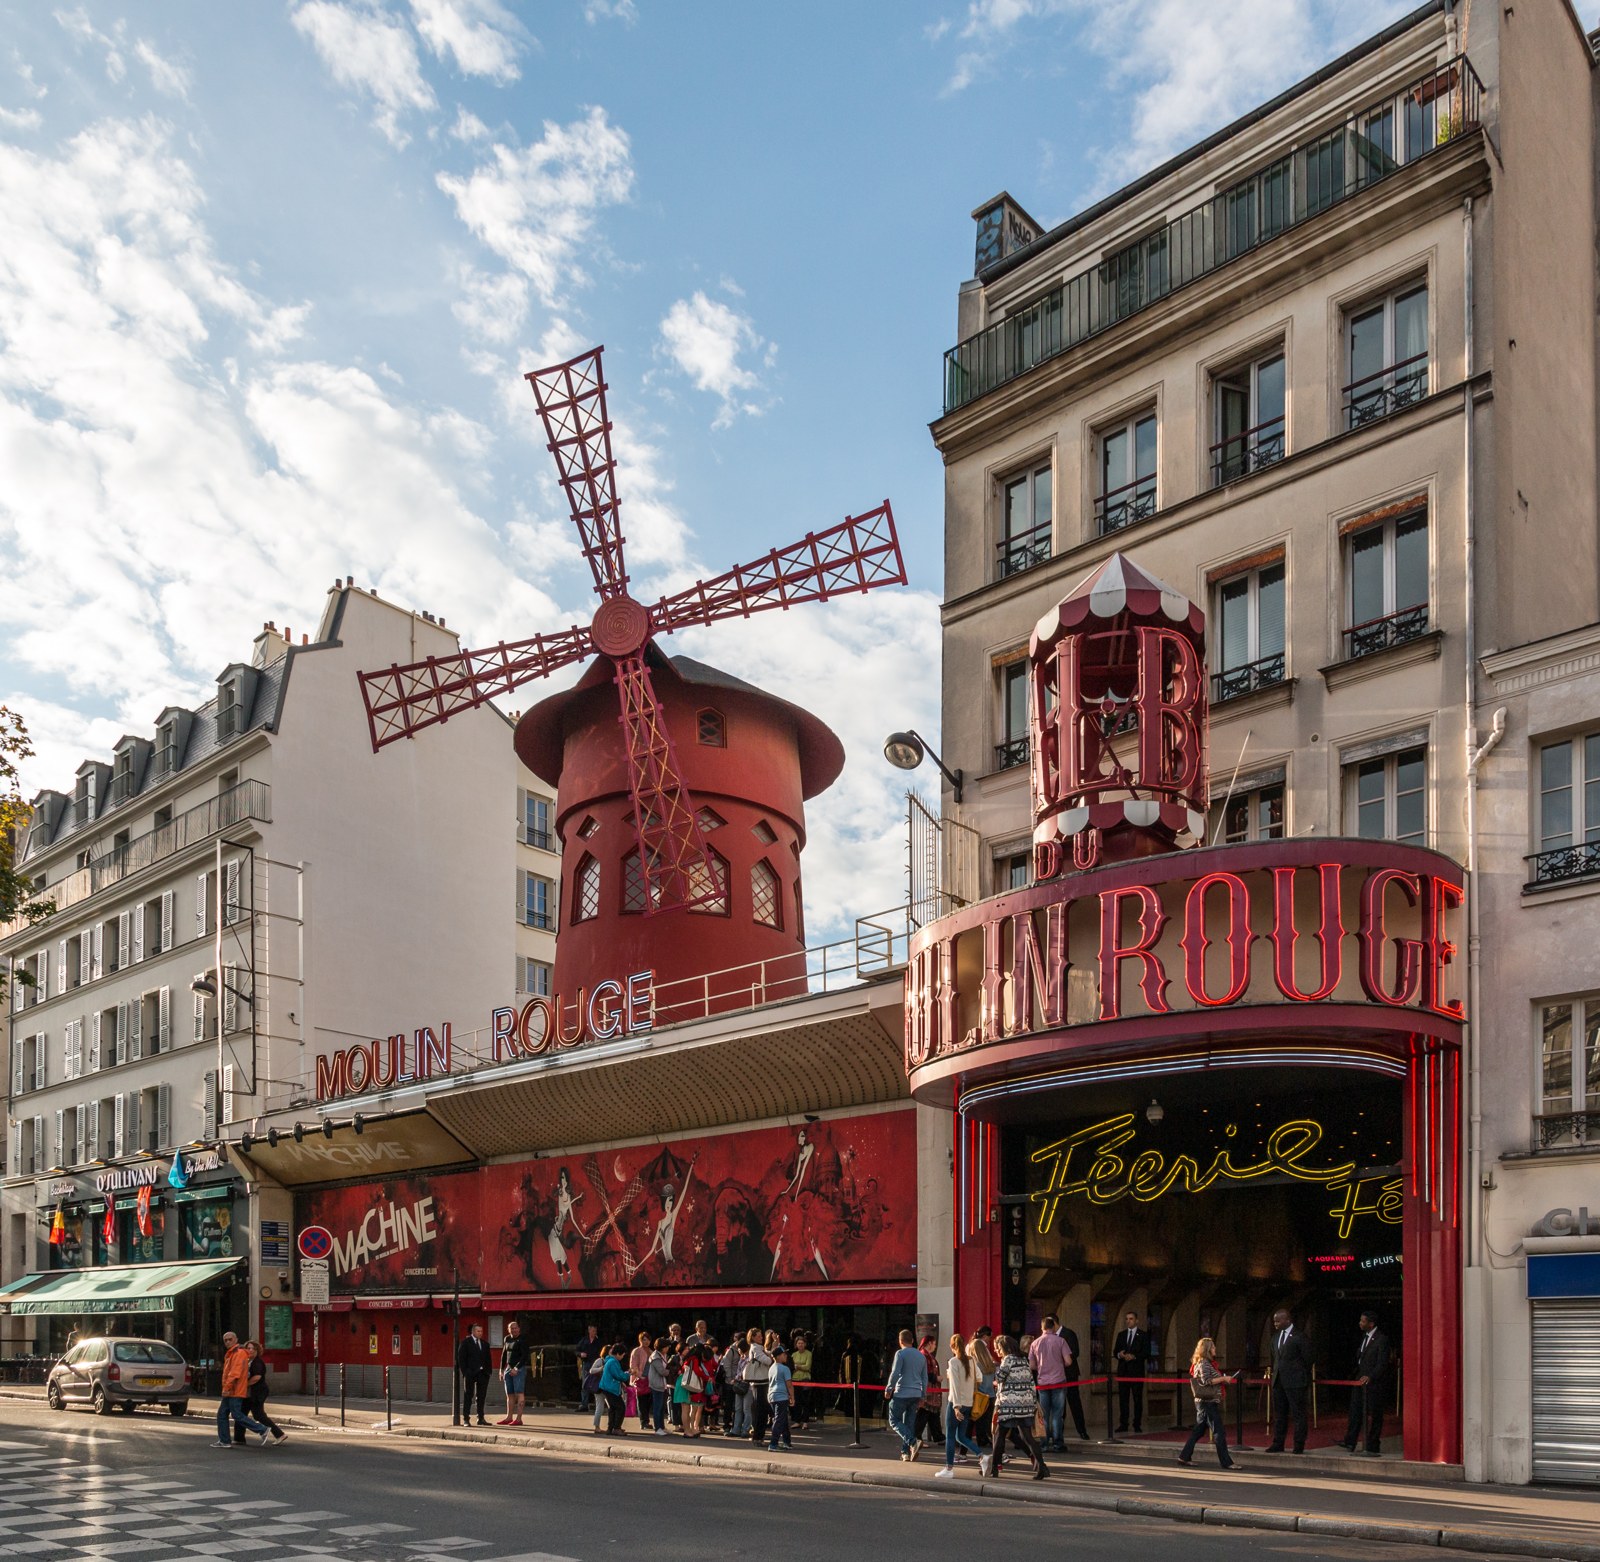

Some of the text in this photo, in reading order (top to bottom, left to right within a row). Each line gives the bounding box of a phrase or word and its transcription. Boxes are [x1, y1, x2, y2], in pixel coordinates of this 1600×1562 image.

[1034, 829, 1102, 879] DU
[904, 863, 1467, 1075] ULIN ROUGE
[315, 968, 657, 1101] MOULIN ROUGE
[96, 1165, 160, 1192] O'SULLIVANS
[1030, 1113, 1356, 1235] Féerie
[333, 1196, 437, 1277] MACHINE
[1361, 1260, 1373, 1269] LE
[1373, 1255, 1394, 1267] PLUS
[368, 1300, 393, 1308] CONCERTS
